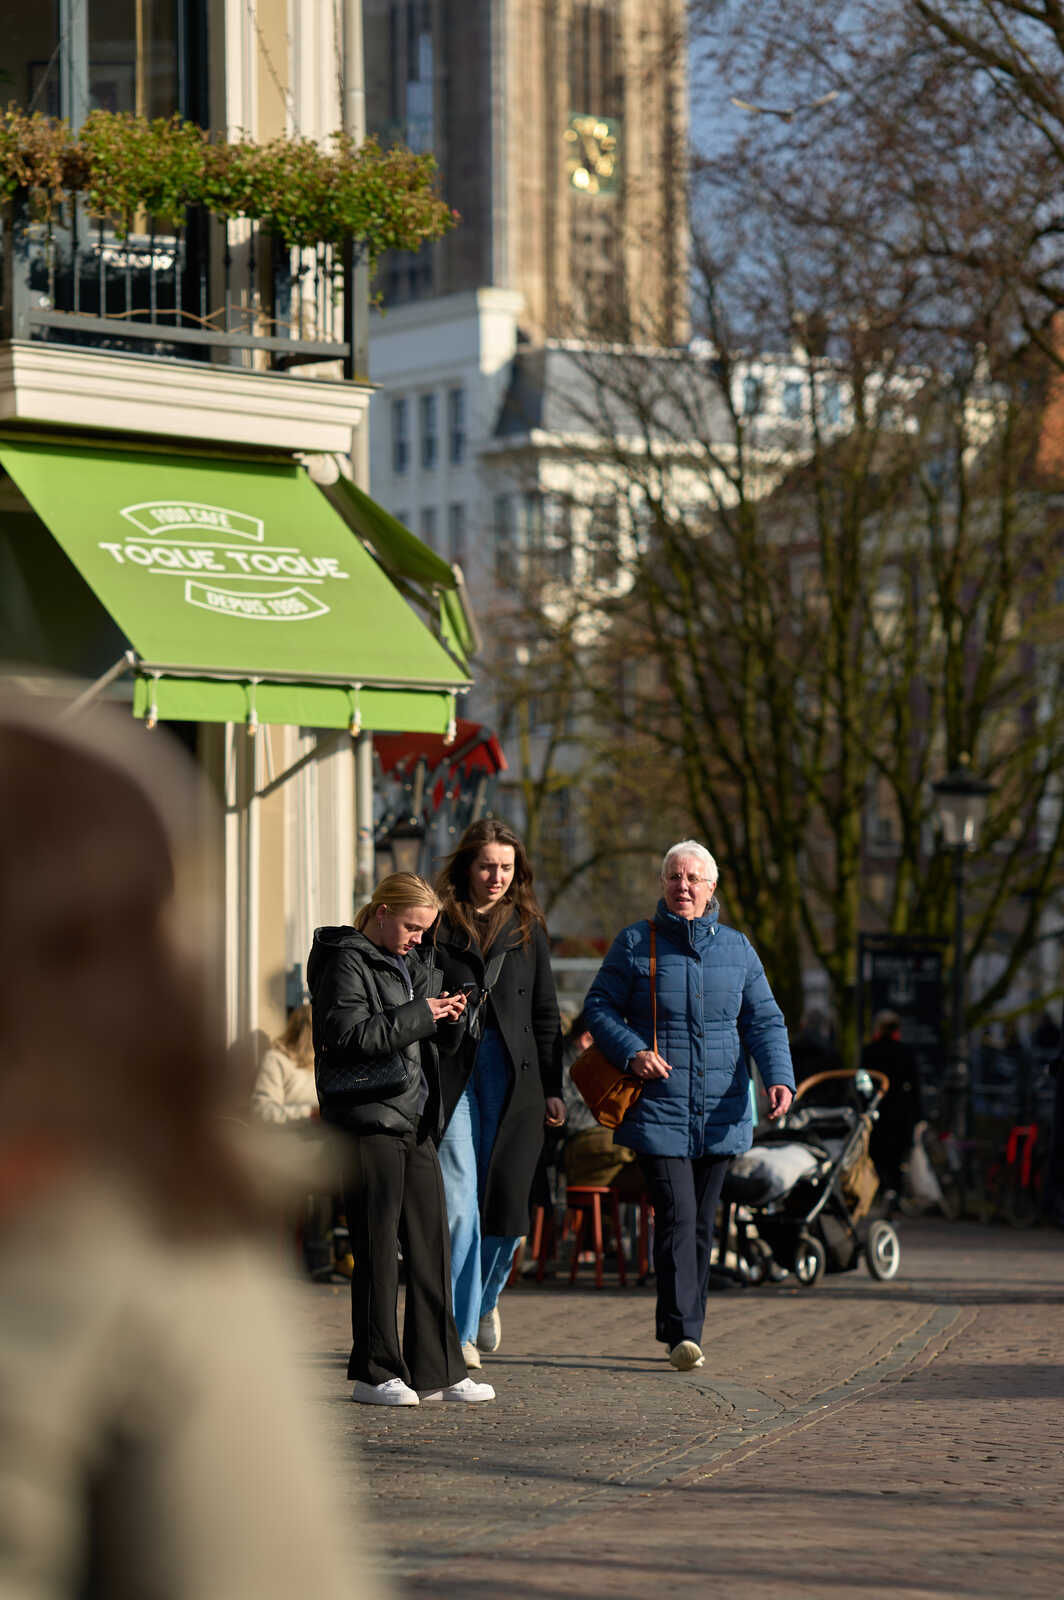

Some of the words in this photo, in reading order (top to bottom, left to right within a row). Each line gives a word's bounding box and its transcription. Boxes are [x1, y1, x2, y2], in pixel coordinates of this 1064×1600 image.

[149, 507, 191, 525] FOOD
[98, 542, 225, 570] TOQUE
[225, 551, 350, 578] TOQUE
[206, 591, 268, 615] DEPUIS
